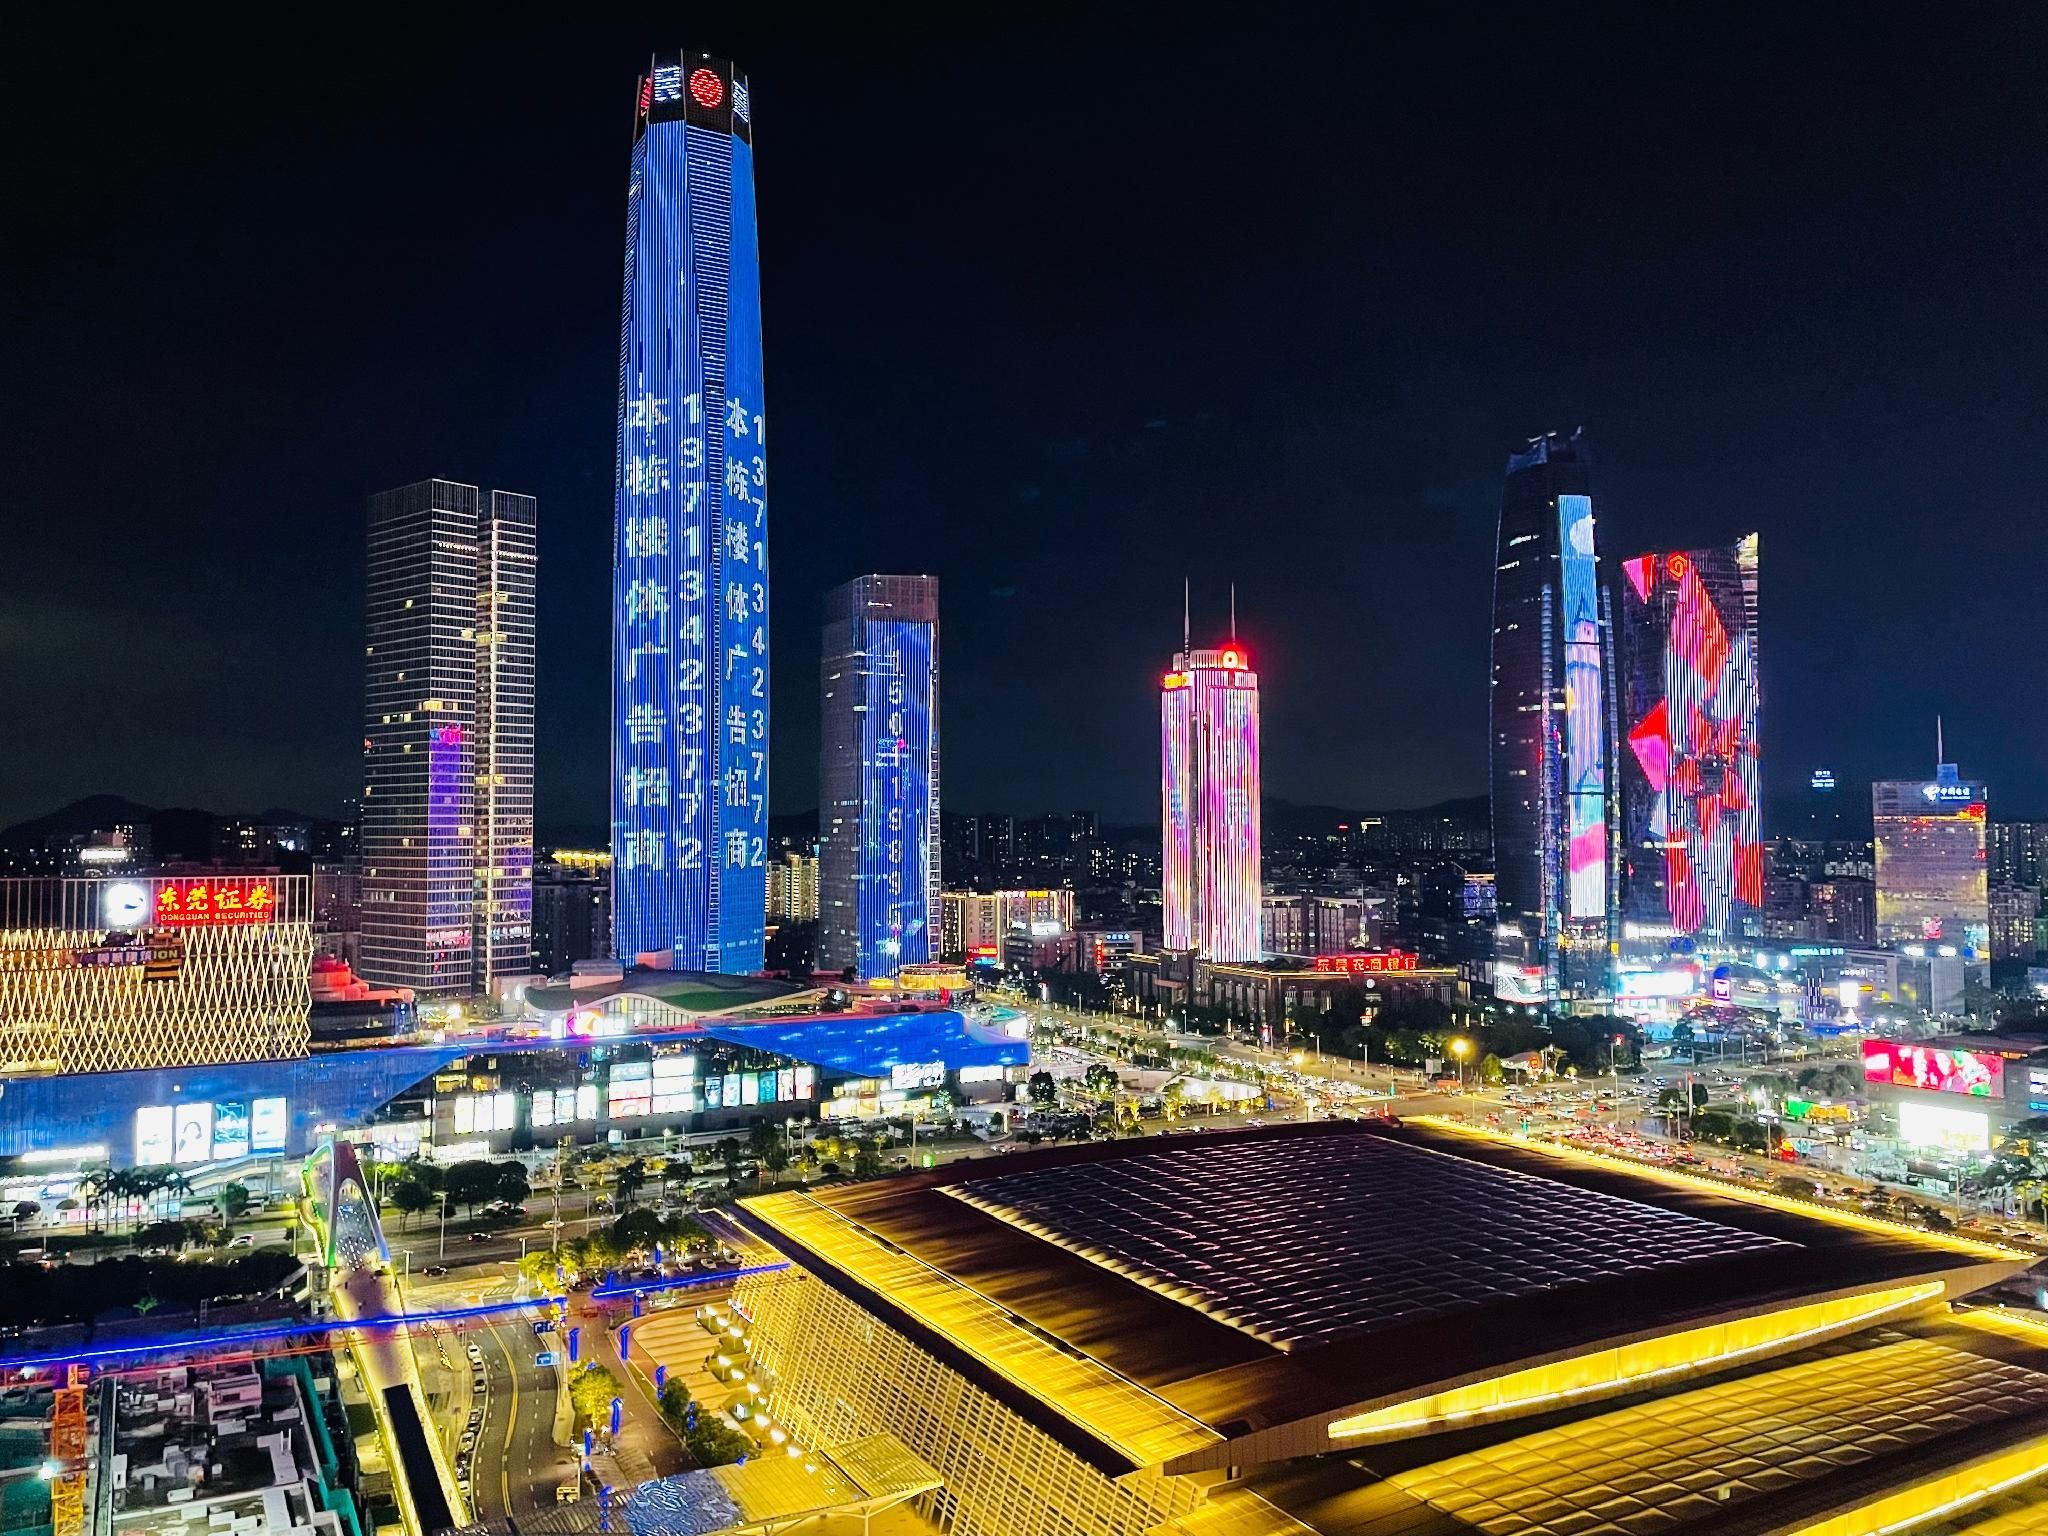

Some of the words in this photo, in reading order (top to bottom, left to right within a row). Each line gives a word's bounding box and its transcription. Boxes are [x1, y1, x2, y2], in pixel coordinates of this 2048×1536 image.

[625, 392, 670, 870] 本栋楼体广告招商
[725, 398, 749, 869] 本栋楼体广告招商
[751, 415, 765, 867] 13713423772
[158, 885, 272, 911] 东莞证券
[161, 913, 209, 921] DONGGUAN
[215, 911, 269, 920] SECURITIES
